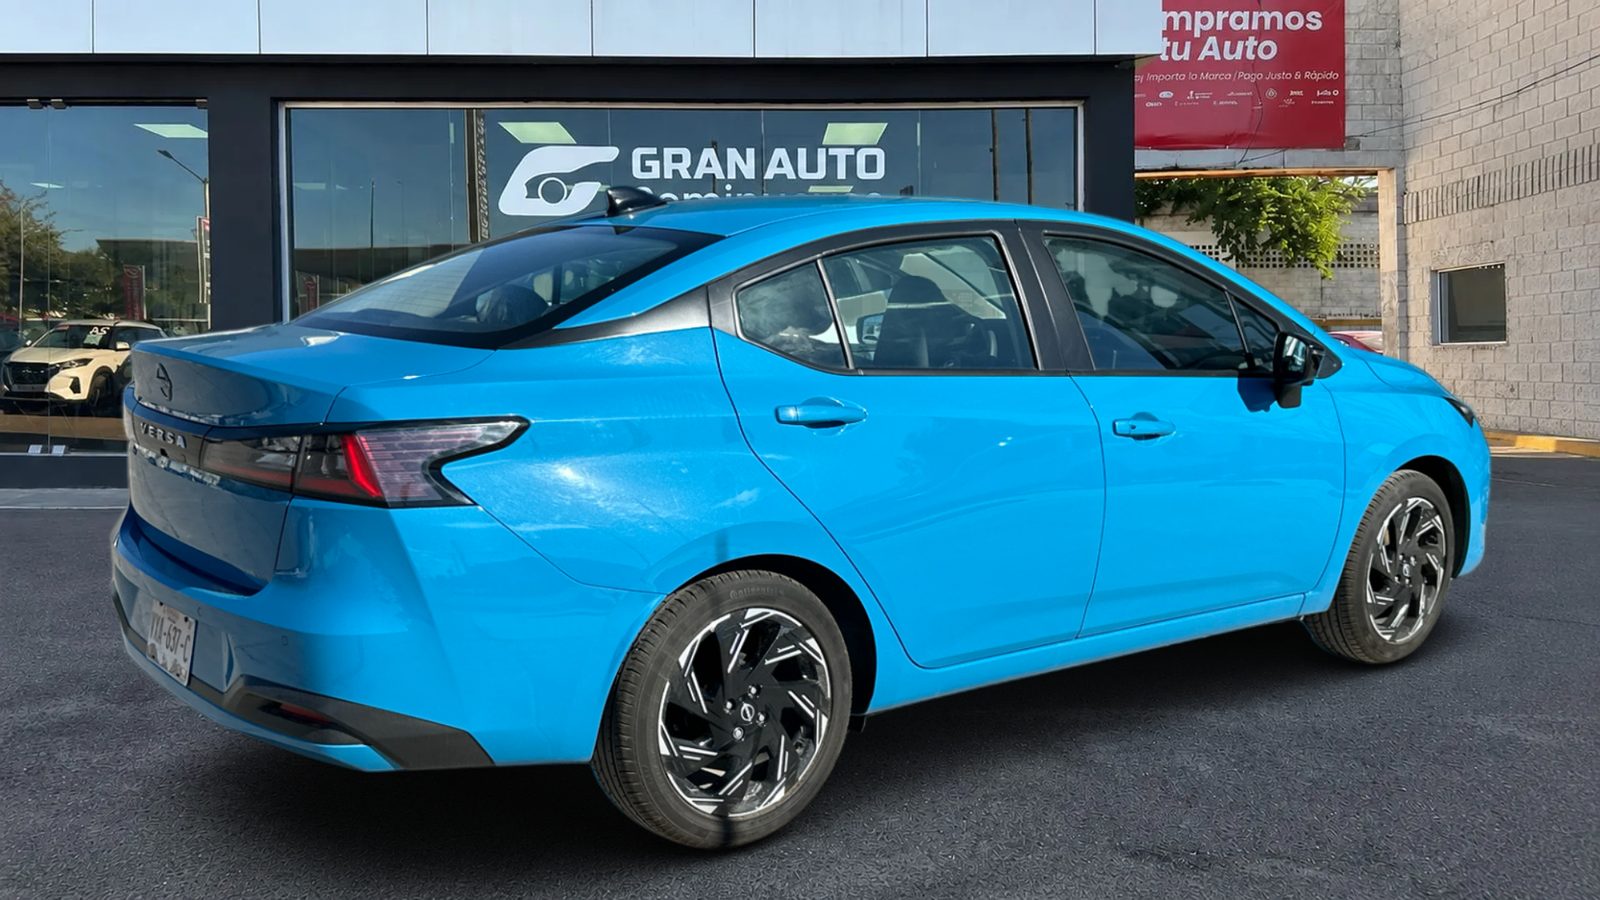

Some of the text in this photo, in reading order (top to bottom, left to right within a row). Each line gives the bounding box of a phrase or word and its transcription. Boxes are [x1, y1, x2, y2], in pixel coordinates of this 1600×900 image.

[1161, 10, 1323, 38] mpramos
[1160, 35, 1278, 61] tu Auto
[1146, 72, 1186, 83] Importa
[1199, 71, 1232, 80] Marca
[1265, 71, 1292, 80] Justo
[1294, 71, 1301, 80] &
[1304, 70, 1339, 82] Rápido
[632, 147, 885, 180] GRAN AUTO
[140, 422, 187, 449] VERSA
